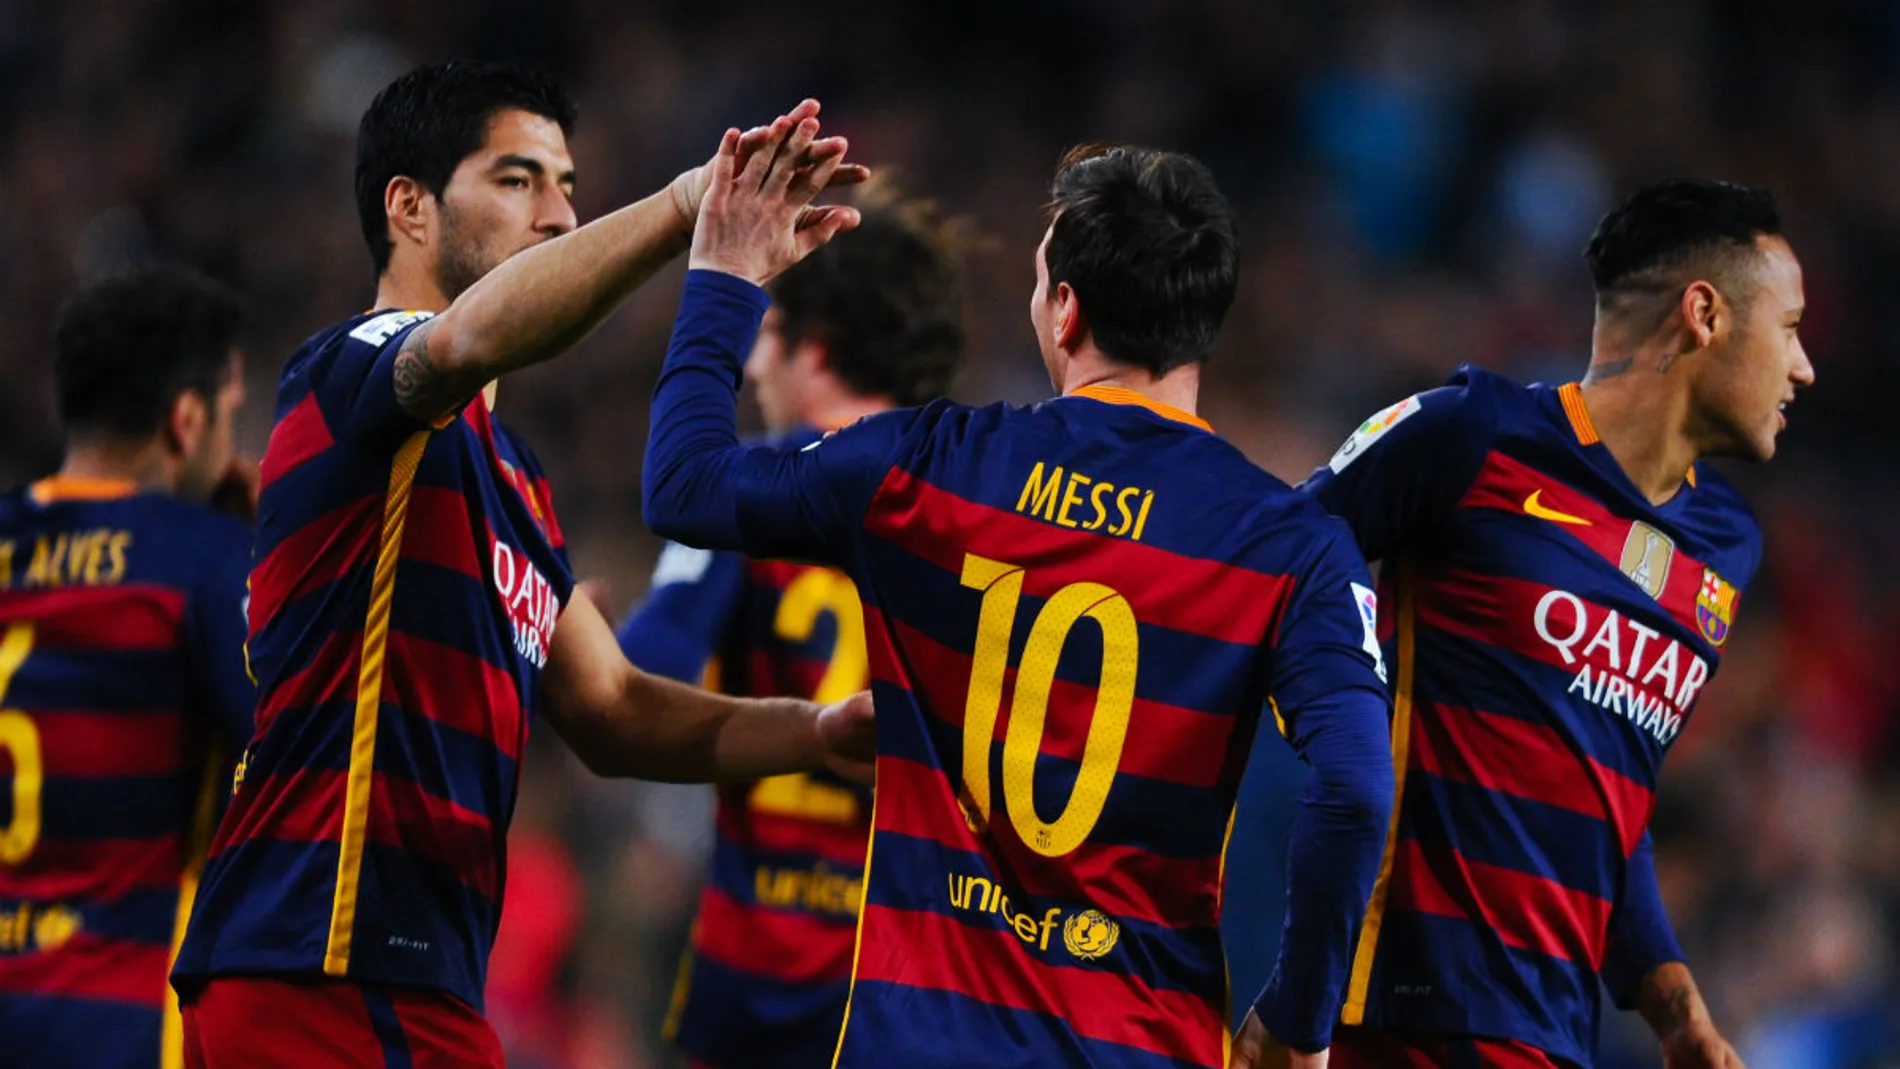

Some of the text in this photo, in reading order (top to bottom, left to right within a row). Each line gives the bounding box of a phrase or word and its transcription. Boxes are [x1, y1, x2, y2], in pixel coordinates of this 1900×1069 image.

[1015, 461, 1155, 541] MESSI
[24, 529, 132, 586] ALVES
[494, 540, 559, 645] QATAR
[749, 568, 869, 824] 2
[1533, 590, 1708, 712] QATAR
[957, 552, 1139, 858] 10
[1568, 663, 1681, 745] AIRWAYS
[949, 873, 1062, 951] unicef
